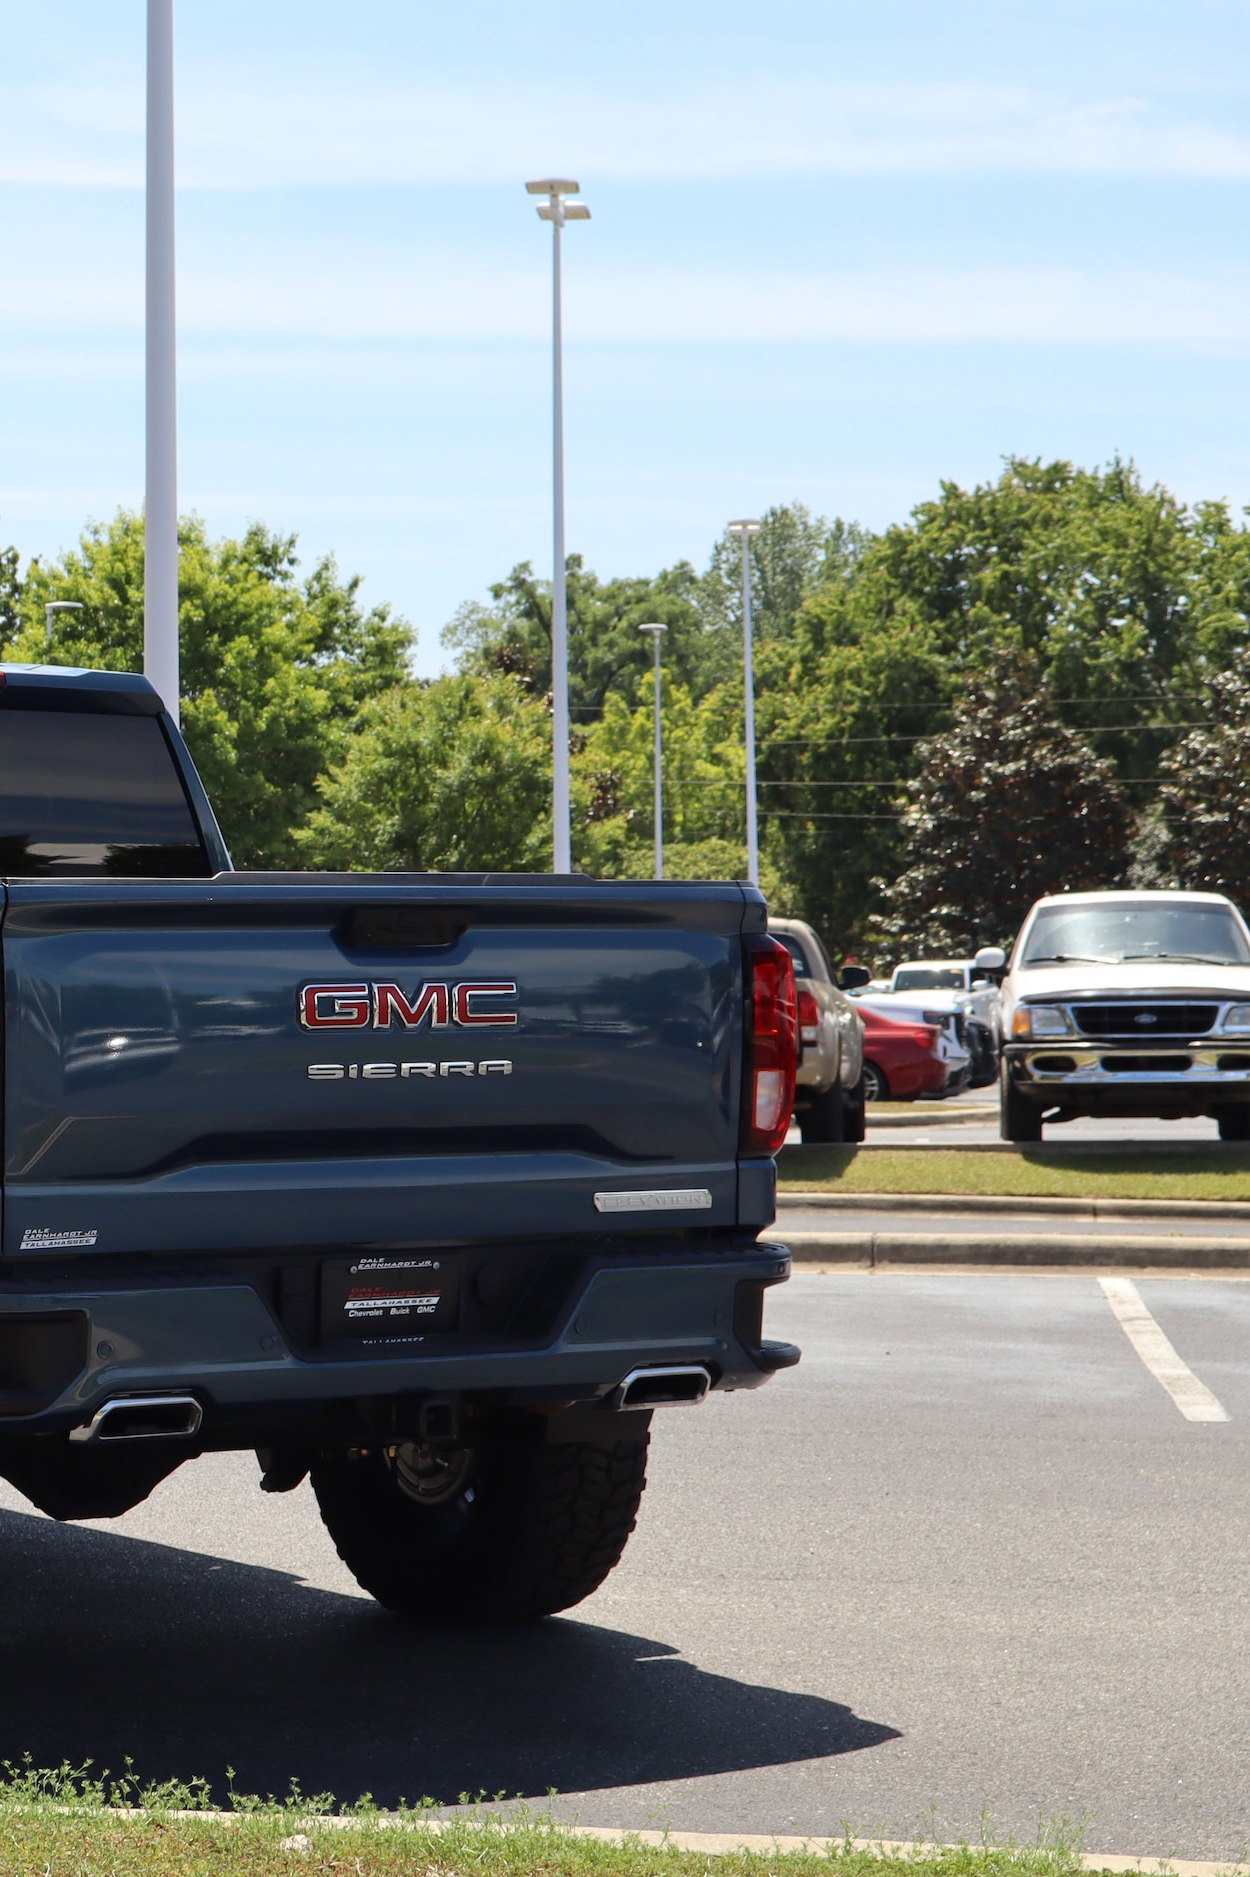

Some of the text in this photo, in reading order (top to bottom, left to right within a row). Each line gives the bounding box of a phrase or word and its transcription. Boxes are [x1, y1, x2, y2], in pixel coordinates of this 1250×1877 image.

[300, 982, 518, 1029] GMC
[307, 1059, 513, 1080] SIERRA
[22, 1231, 83, 1239] EARNHARDT
[25, 1239, 92, 1247] TALLAHASSEE
[358, 1261, 417, 1269] EARNHARDT
[349, 1290, 421, 1298] EARNHARDT
[352, 1299, 433, 1307] TALLAHASSEE
[348, 1309, 383, 1317] Chevrolet
[390, 1307, 410, 1315] Buick
